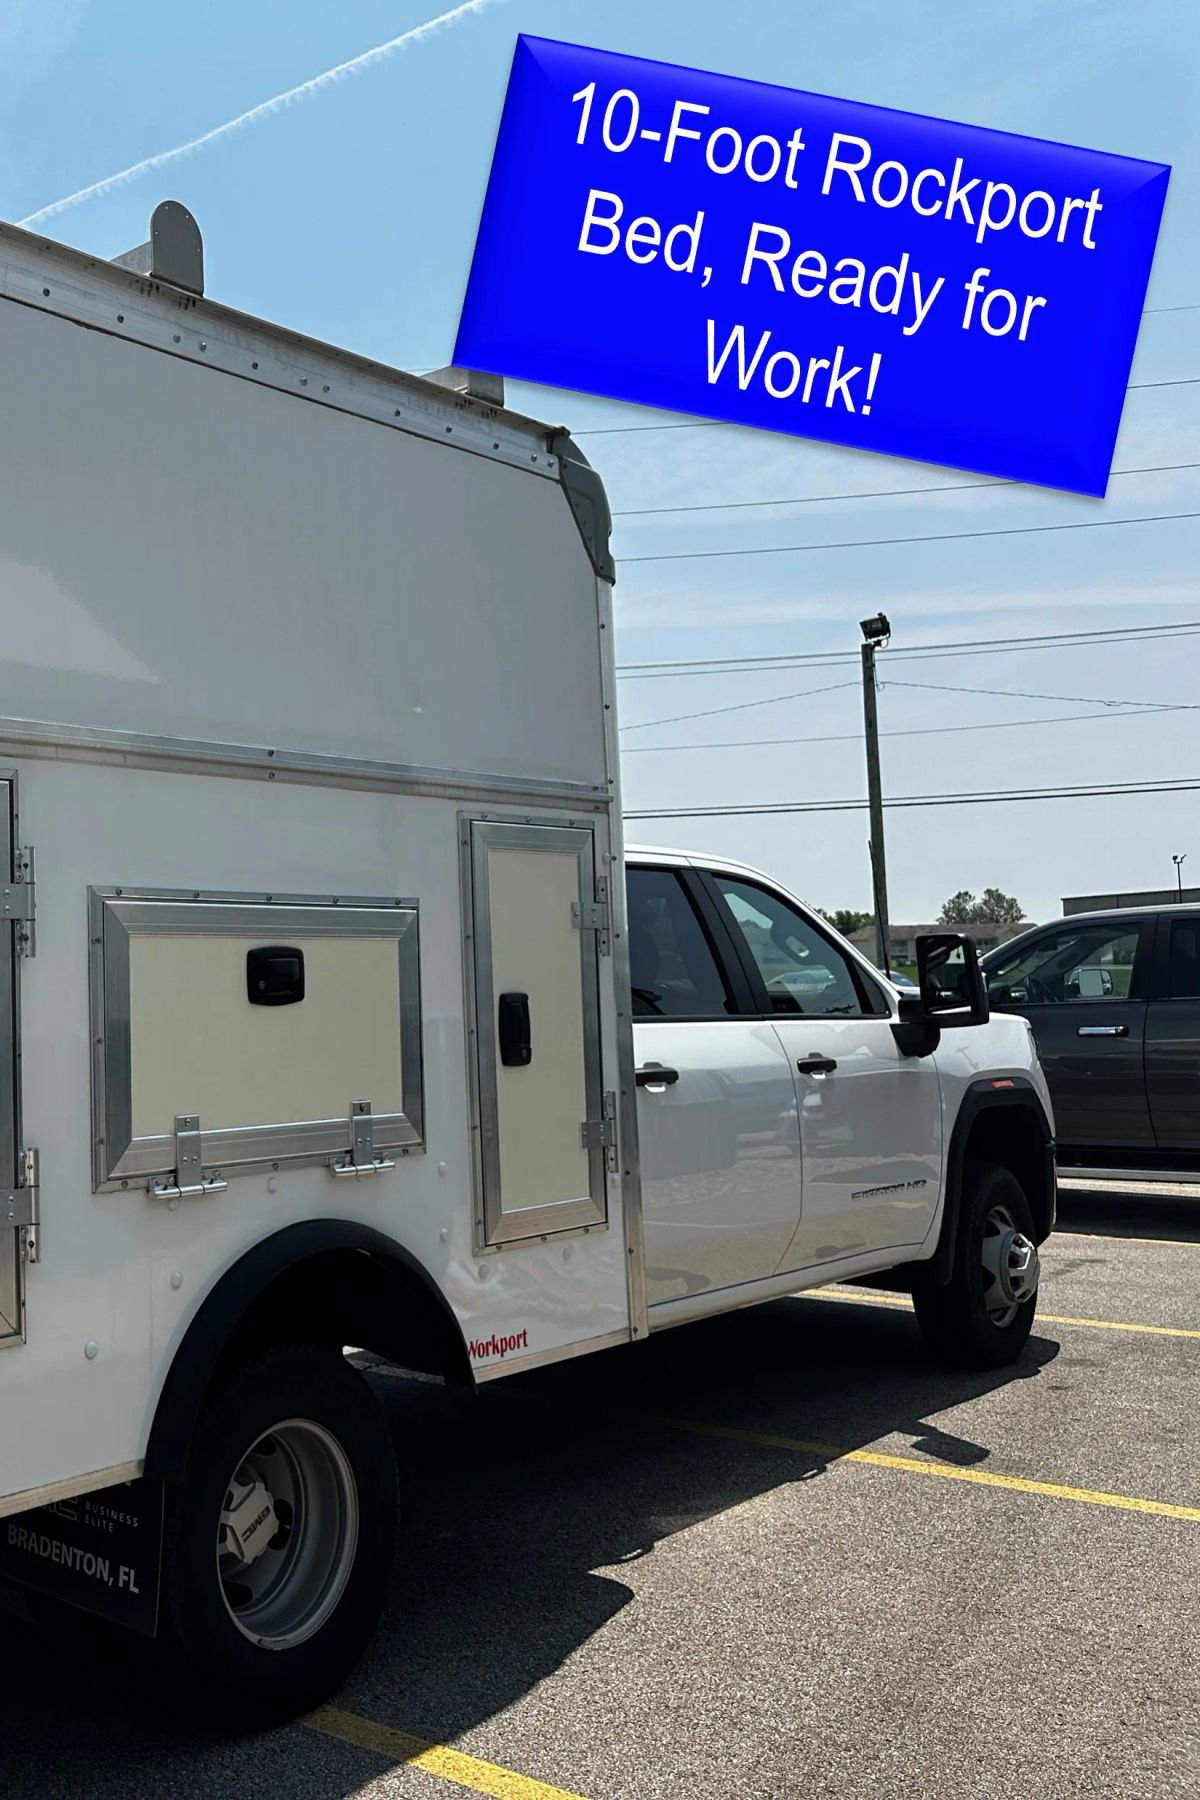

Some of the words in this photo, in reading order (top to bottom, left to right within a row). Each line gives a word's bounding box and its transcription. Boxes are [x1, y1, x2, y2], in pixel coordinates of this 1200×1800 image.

[84, 1501, 140, 1528] BUSINESS
[84, 1514, 115, 1534] ELITE
[7, 1522, 115, 1588] BRADENTON,
[118, 1564, 141, 1595] FL
